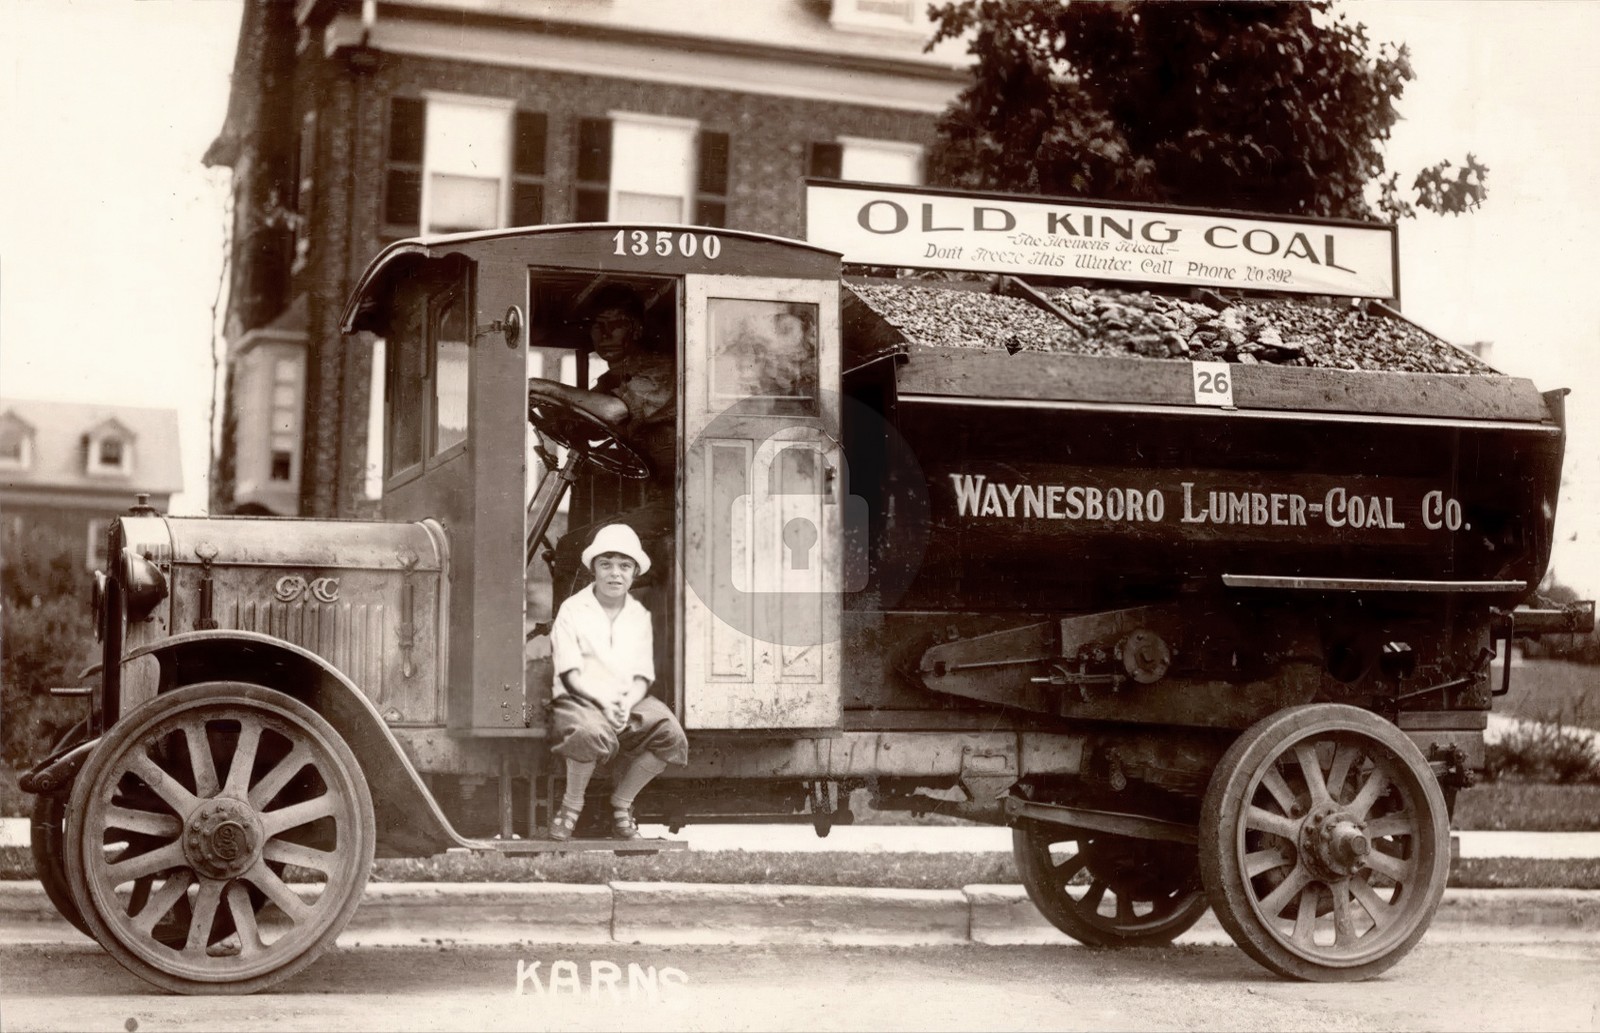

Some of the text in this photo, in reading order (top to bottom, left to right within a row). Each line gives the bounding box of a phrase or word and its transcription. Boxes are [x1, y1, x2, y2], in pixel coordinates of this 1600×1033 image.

[612, 229, 721, 260] 13500
[857, 199, 1357, 275] OLD KING COAL
[971, 247, 1025, 265] Freeze
[1027, 251, 1066, 267] This
[1140, 258, 1173, 275] Call
[1186, 261, 1237, 281] Phone
[1197, 371, 1229, 395] 26
[948, 473, 1165, 523] WAYNESBORO
